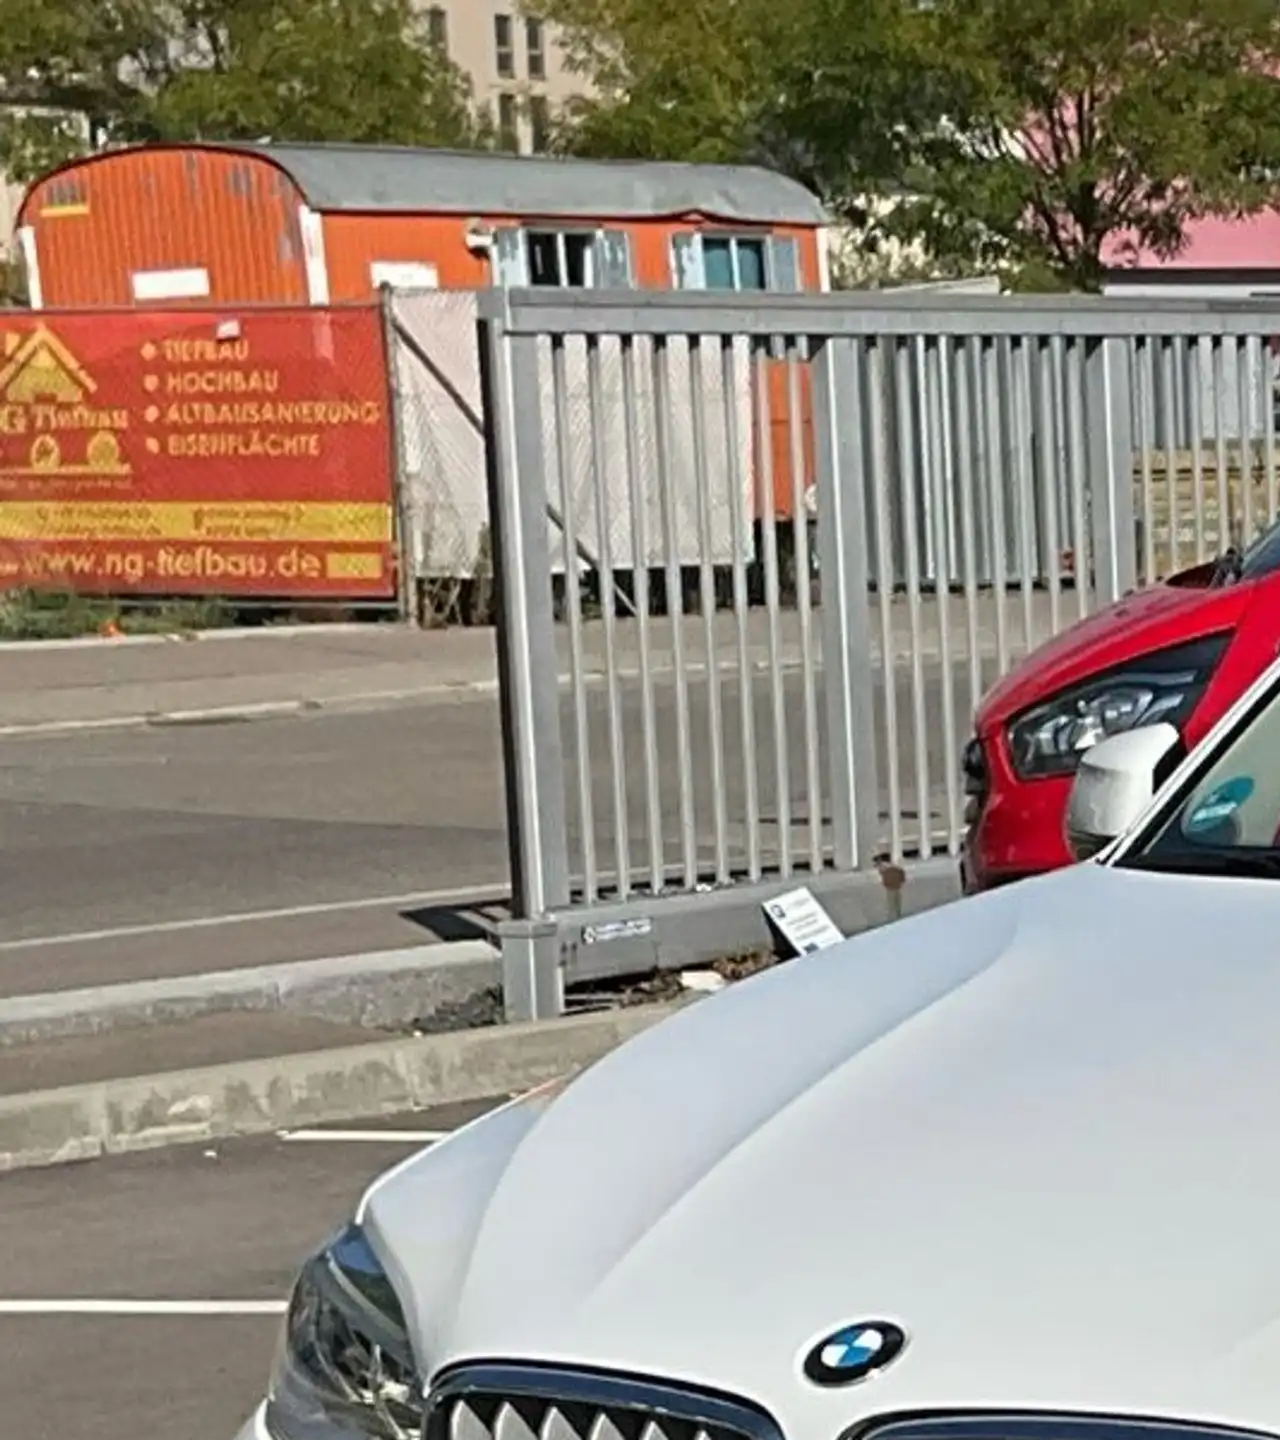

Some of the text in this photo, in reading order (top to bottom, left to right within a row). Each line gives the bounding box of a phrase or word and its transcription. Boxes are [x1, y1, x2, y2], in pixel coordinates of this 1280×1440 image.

[164, 339, 249, 362] TIEFBAU
[166, 370, 279, 393] HOCHBAU
[166, 400, 381, 425] ALTBAUSANIERUNG
